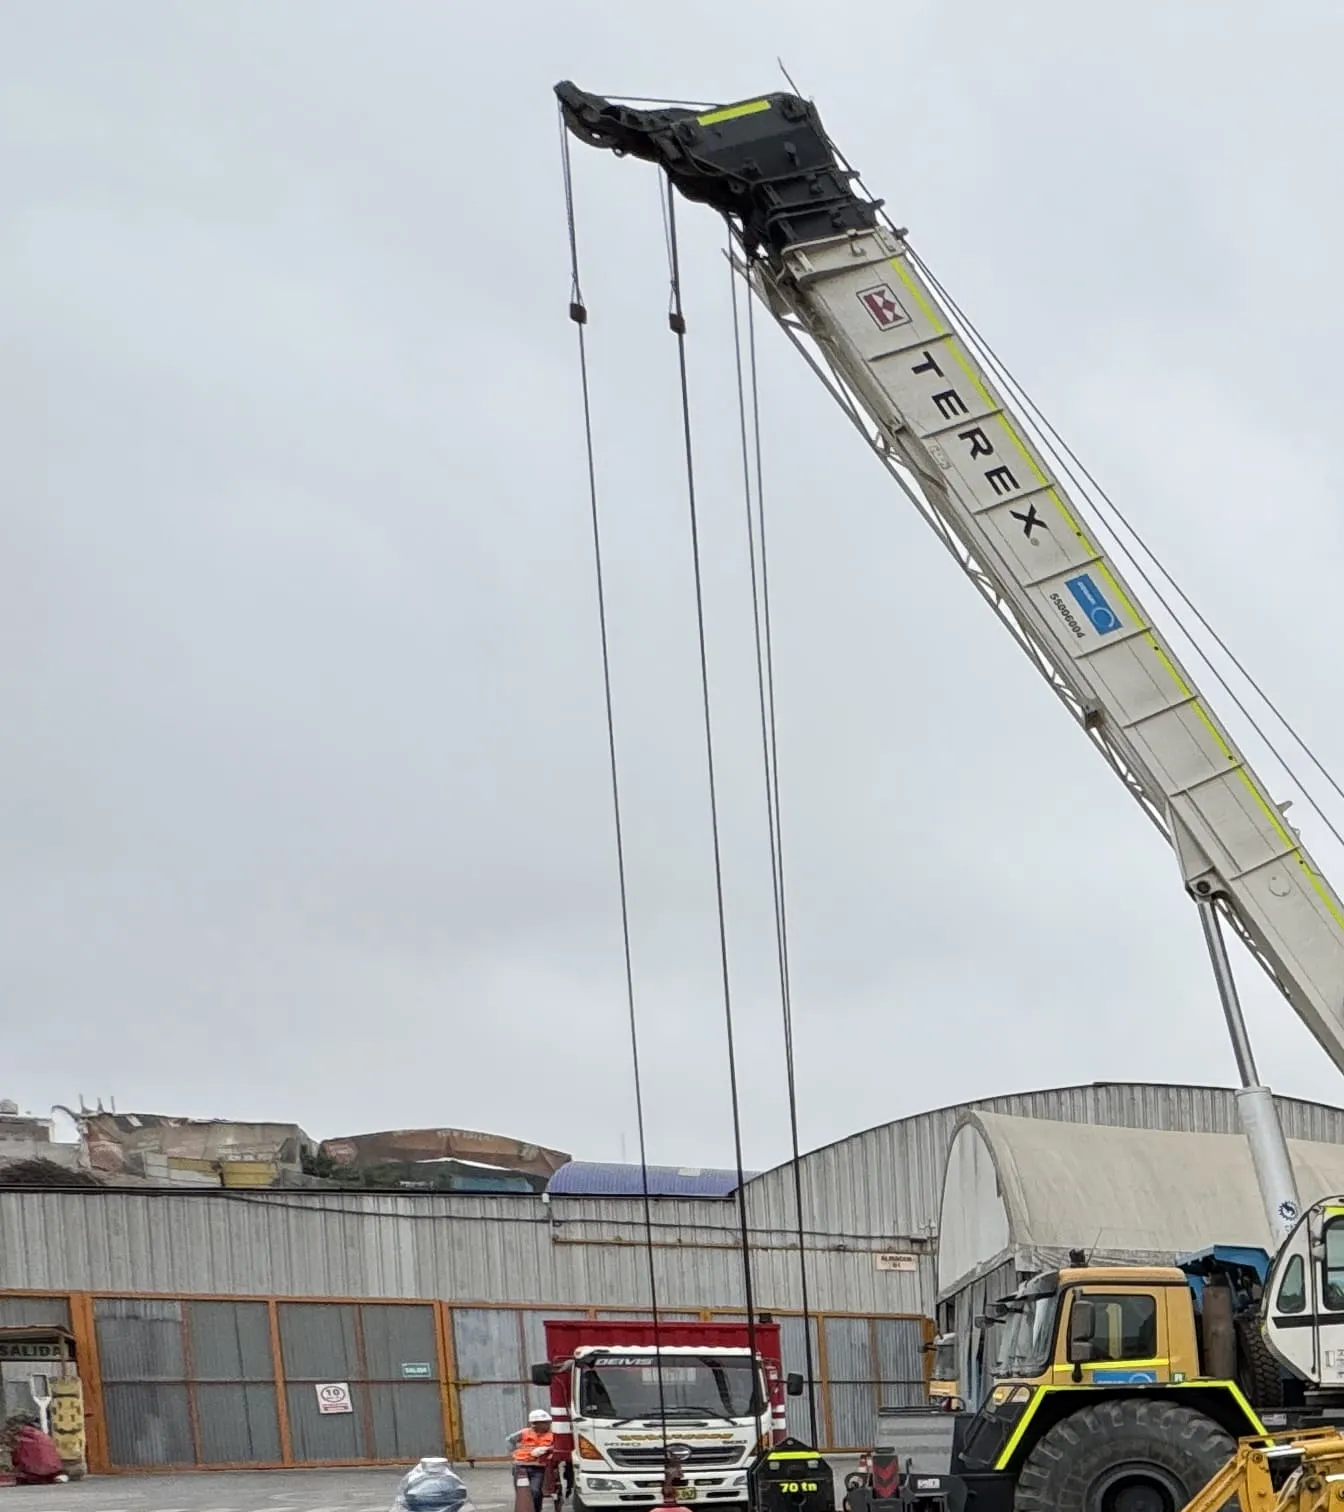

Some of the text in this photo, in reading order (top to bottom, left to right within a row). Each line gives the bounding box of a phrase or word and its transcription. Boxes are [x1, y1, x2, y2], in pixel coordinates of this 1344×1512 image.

[911, 350, 1049, 539] TEREX
[595, 1357, 655, 1366] DEIVIS
[779, 1483, 798, 1493] 70
